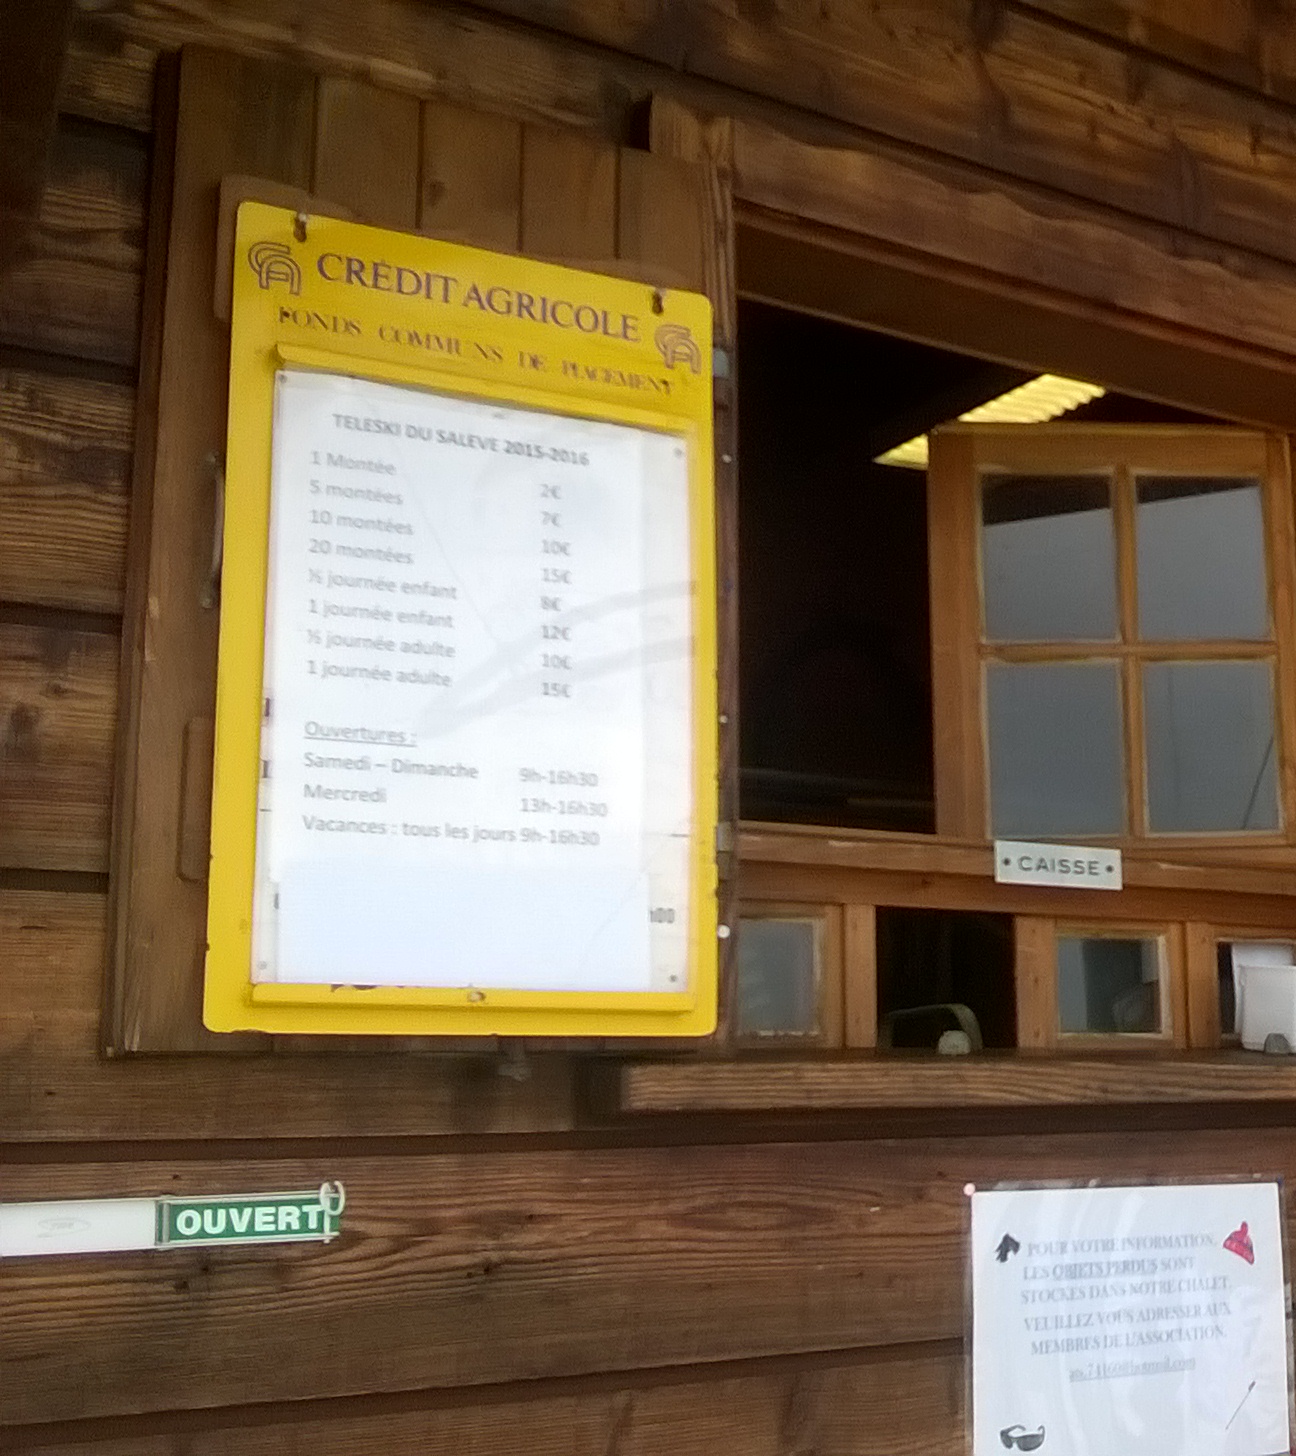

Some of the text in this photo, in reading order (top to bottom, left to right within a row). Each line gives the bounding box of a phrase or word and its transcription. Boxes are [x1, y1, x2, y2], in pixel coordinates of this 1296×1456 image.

[317, 252, 641, 343] CRÉDIT AGRICOLE
[278, 306, 675, 395] FONDS COMMUNS DE PLACEMENT
[332, 413, 590, 466] TELESKI DU SALEVE 2015-2016
[311, 451, 562, 500] 1 Montée 2€
[310, 480, 562, 528] 5 montées 7€
[311, 509, 572, 557] 10 montées 10€
[308, 539, 572, 585] 20 montées 15€
[326, 571, 396, 594] journée
[400, 579, 457, 600] enfant
[540, 596, 562, 612] 8€
[309, 600, 572, 642] 1 journée enfant 12€
[325, 632, 395, 655] journée
[399, 638, 456, 658] adulte
[541, 654, 572, 671] 10€
[307, 660, 572, 699] 1 journée adulte 15€
[304, 752, 371, 772] Samedi
[392, 758, 479, 779] Dimanche
[520, 767, 599, 787] 9h-16h30
[304, 784, 608, 818] Mercredi 13h-16h30
[302, 815, 386, 835] Vacances
[402, 823, 440, 839] tous
[445, 824, 470, 839] les
[473, 826, 516, 844] jours
[520, 827, 600, 846] 9h-16h30
[1017, 856, 1100, 876] CAISSE
[176, 1205, 324, 1235] OUVERT
[1027, 1238, 1068, 1257] POUR
[1070, 1236, 1119, 1254] VOTRE
[1023, 1256, 1195, 1281] LES OBJETS PERDUS SONT
[1089, 1284, 1126, 1299] DANS
[1129, 1280, 1177, 1295] NOTRE
[1024, 1301, 1232, 1332] VEUILLEZ VOUS ADRESSER AUX
[1031, 1336, 1101, 1356] MEMBRES
[1103, 1334, 1122, 1349] DE
